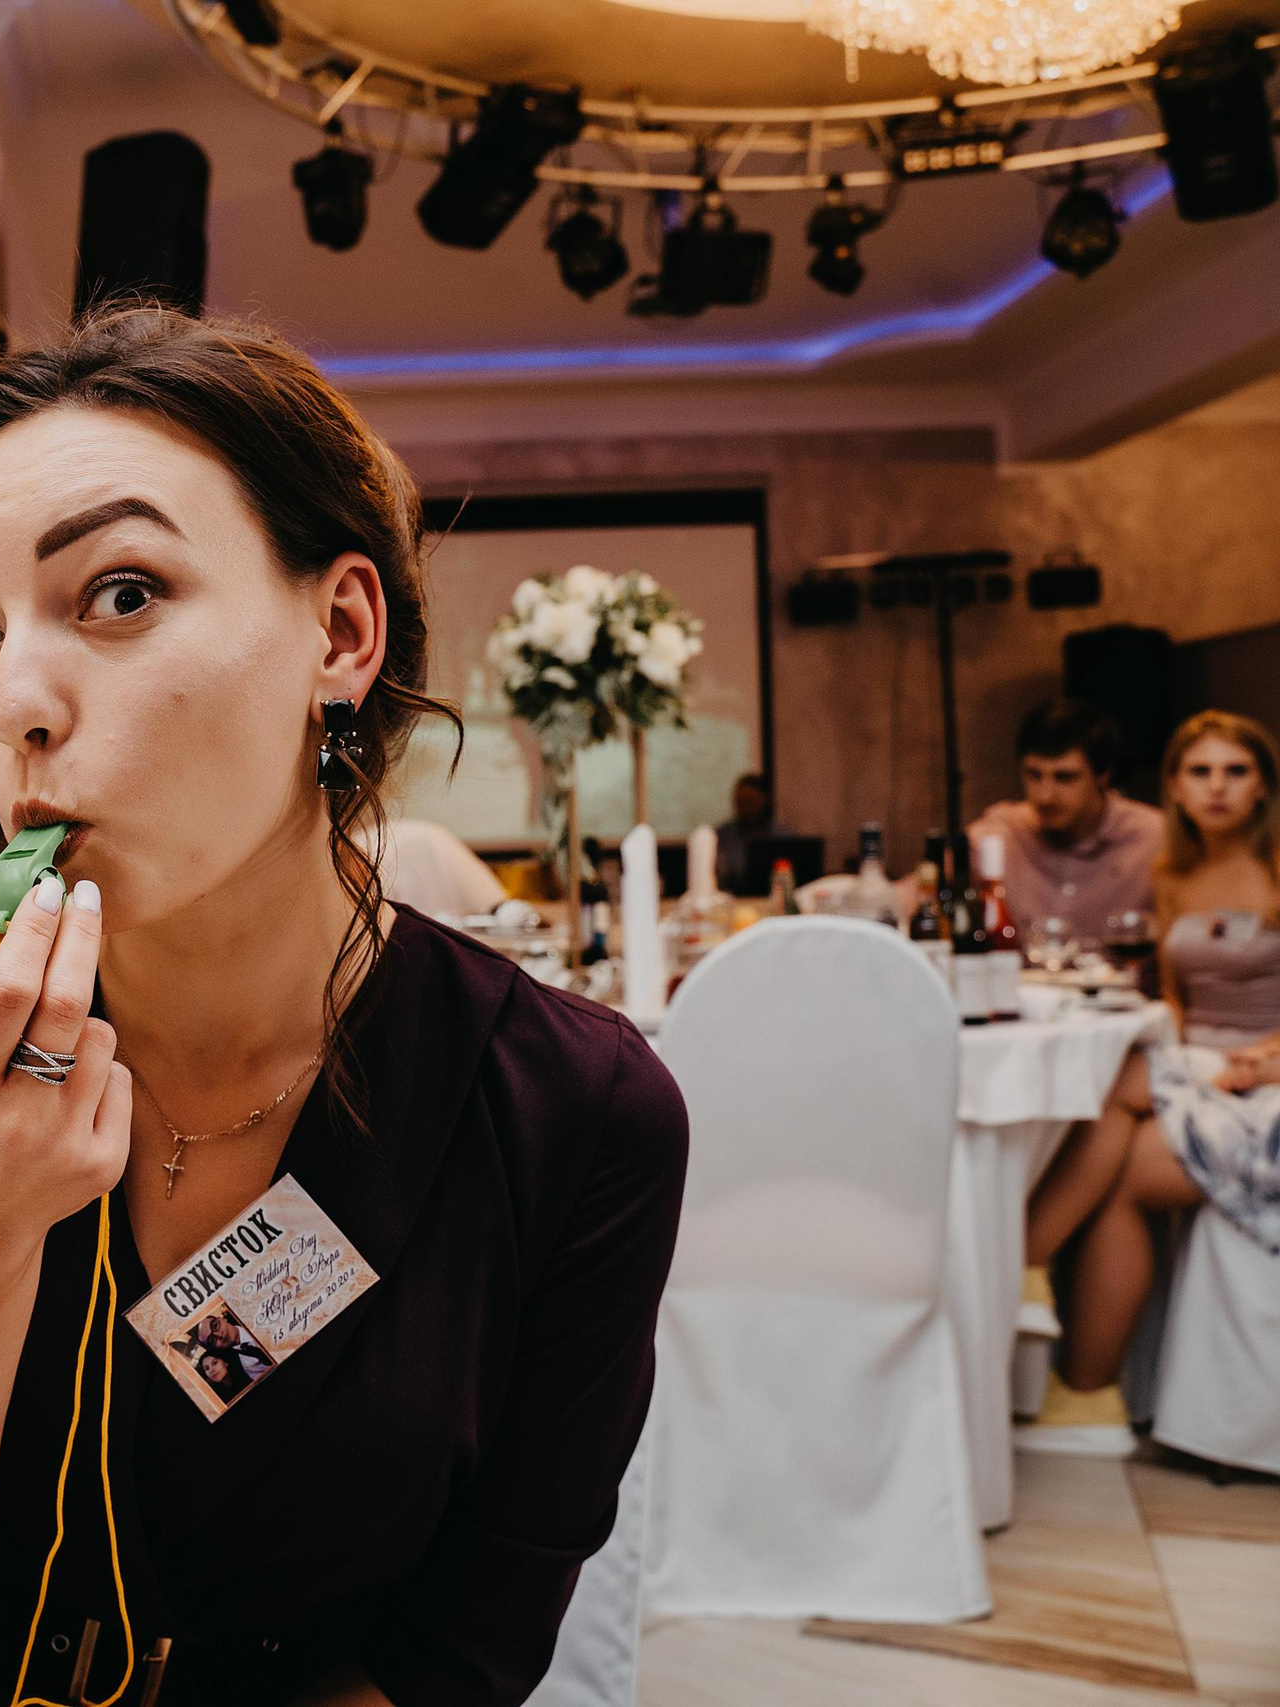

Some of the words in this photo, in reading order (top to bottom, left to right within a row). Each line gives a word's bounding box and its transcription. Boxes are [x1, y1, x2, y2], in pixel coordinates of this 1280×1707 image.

[163, 1208, 283, 1317] СВИСТОК
[242, 1257, 290, 1294] Wedding
[289, 1234, 318, 1258] Day
[273, 1328, 285, 1346] 15
[288, 1296, 324, 1332] августа
